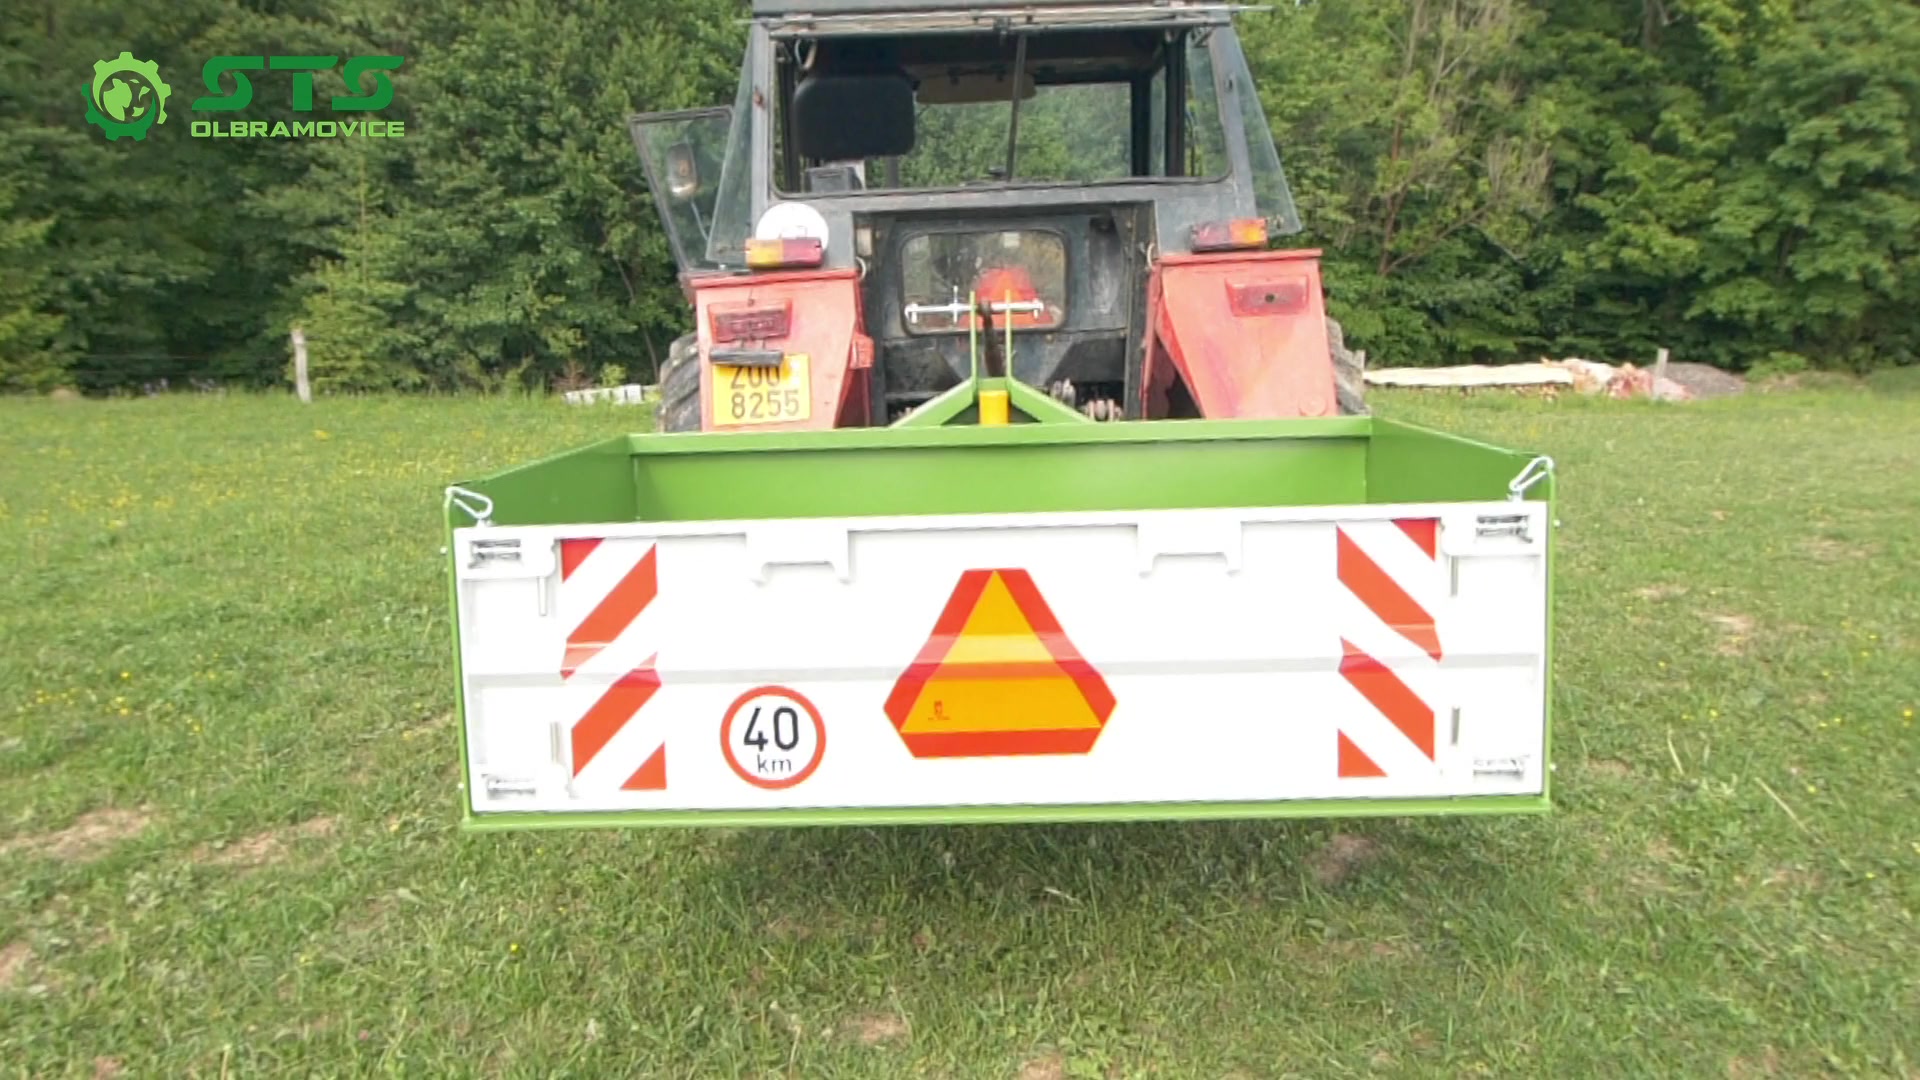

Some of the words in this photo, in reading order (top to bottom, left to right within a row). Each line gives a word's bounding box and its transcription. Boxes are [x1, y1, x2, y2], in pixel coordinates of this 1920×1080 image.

[731, 390, 799, 419] 8255
[743, 706, 799, 751] 40
[757, 754, 791, 773] km
